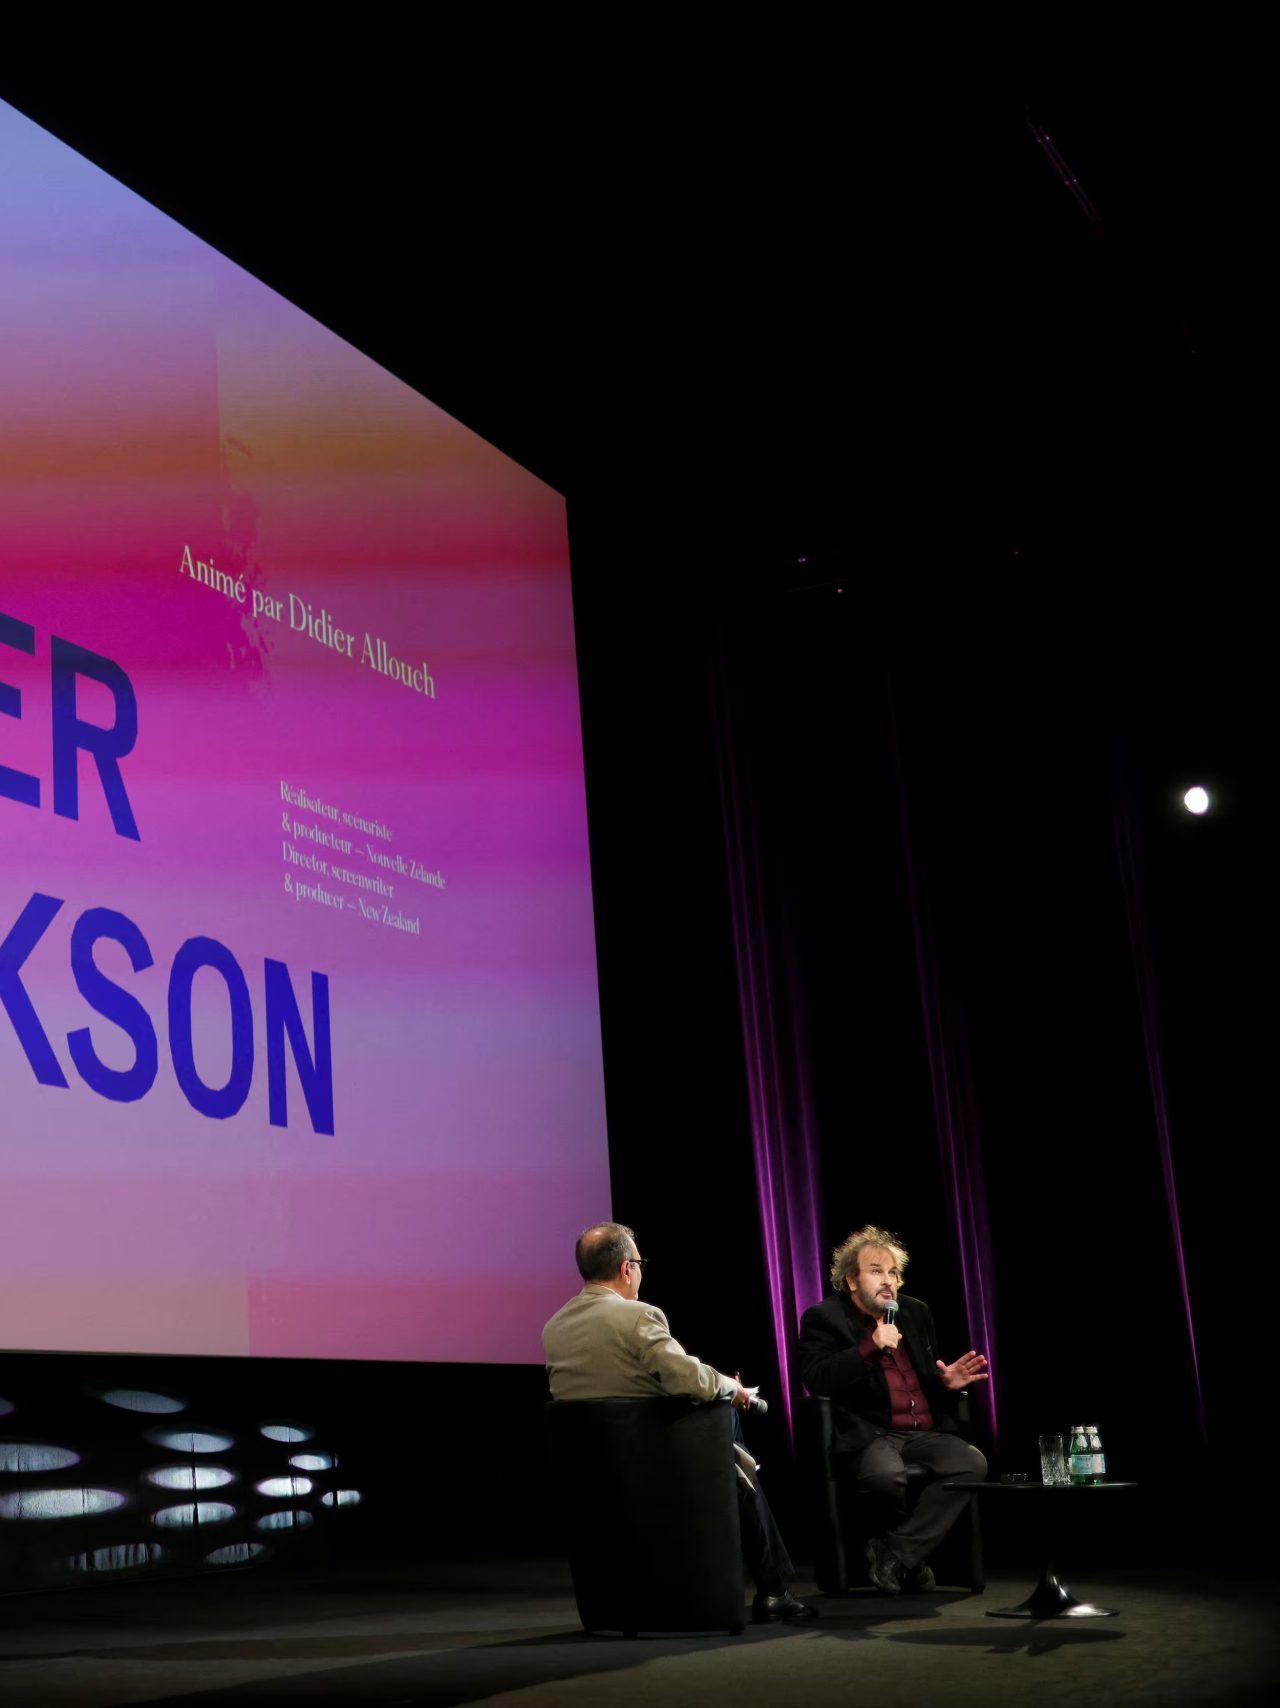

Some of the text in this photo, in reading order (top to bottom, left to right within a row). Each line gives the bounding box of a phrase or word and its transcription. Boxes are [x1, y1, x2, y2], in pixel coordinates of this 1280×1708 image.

[179, 544, 436, 700] Animé par Didier Allouch
[282, 812, 292, 832] &
[293, 819, 352, 855] producteur
[366, 843, 408, 876] Nouvelle
[282, 841, 394, 898] Director, screenwriter
[283, 871, 294, 892] &
[296, 880, 345, 910] producer
[358, 896, 380, 922] New
[381, 904, 420, 935] Zealand
